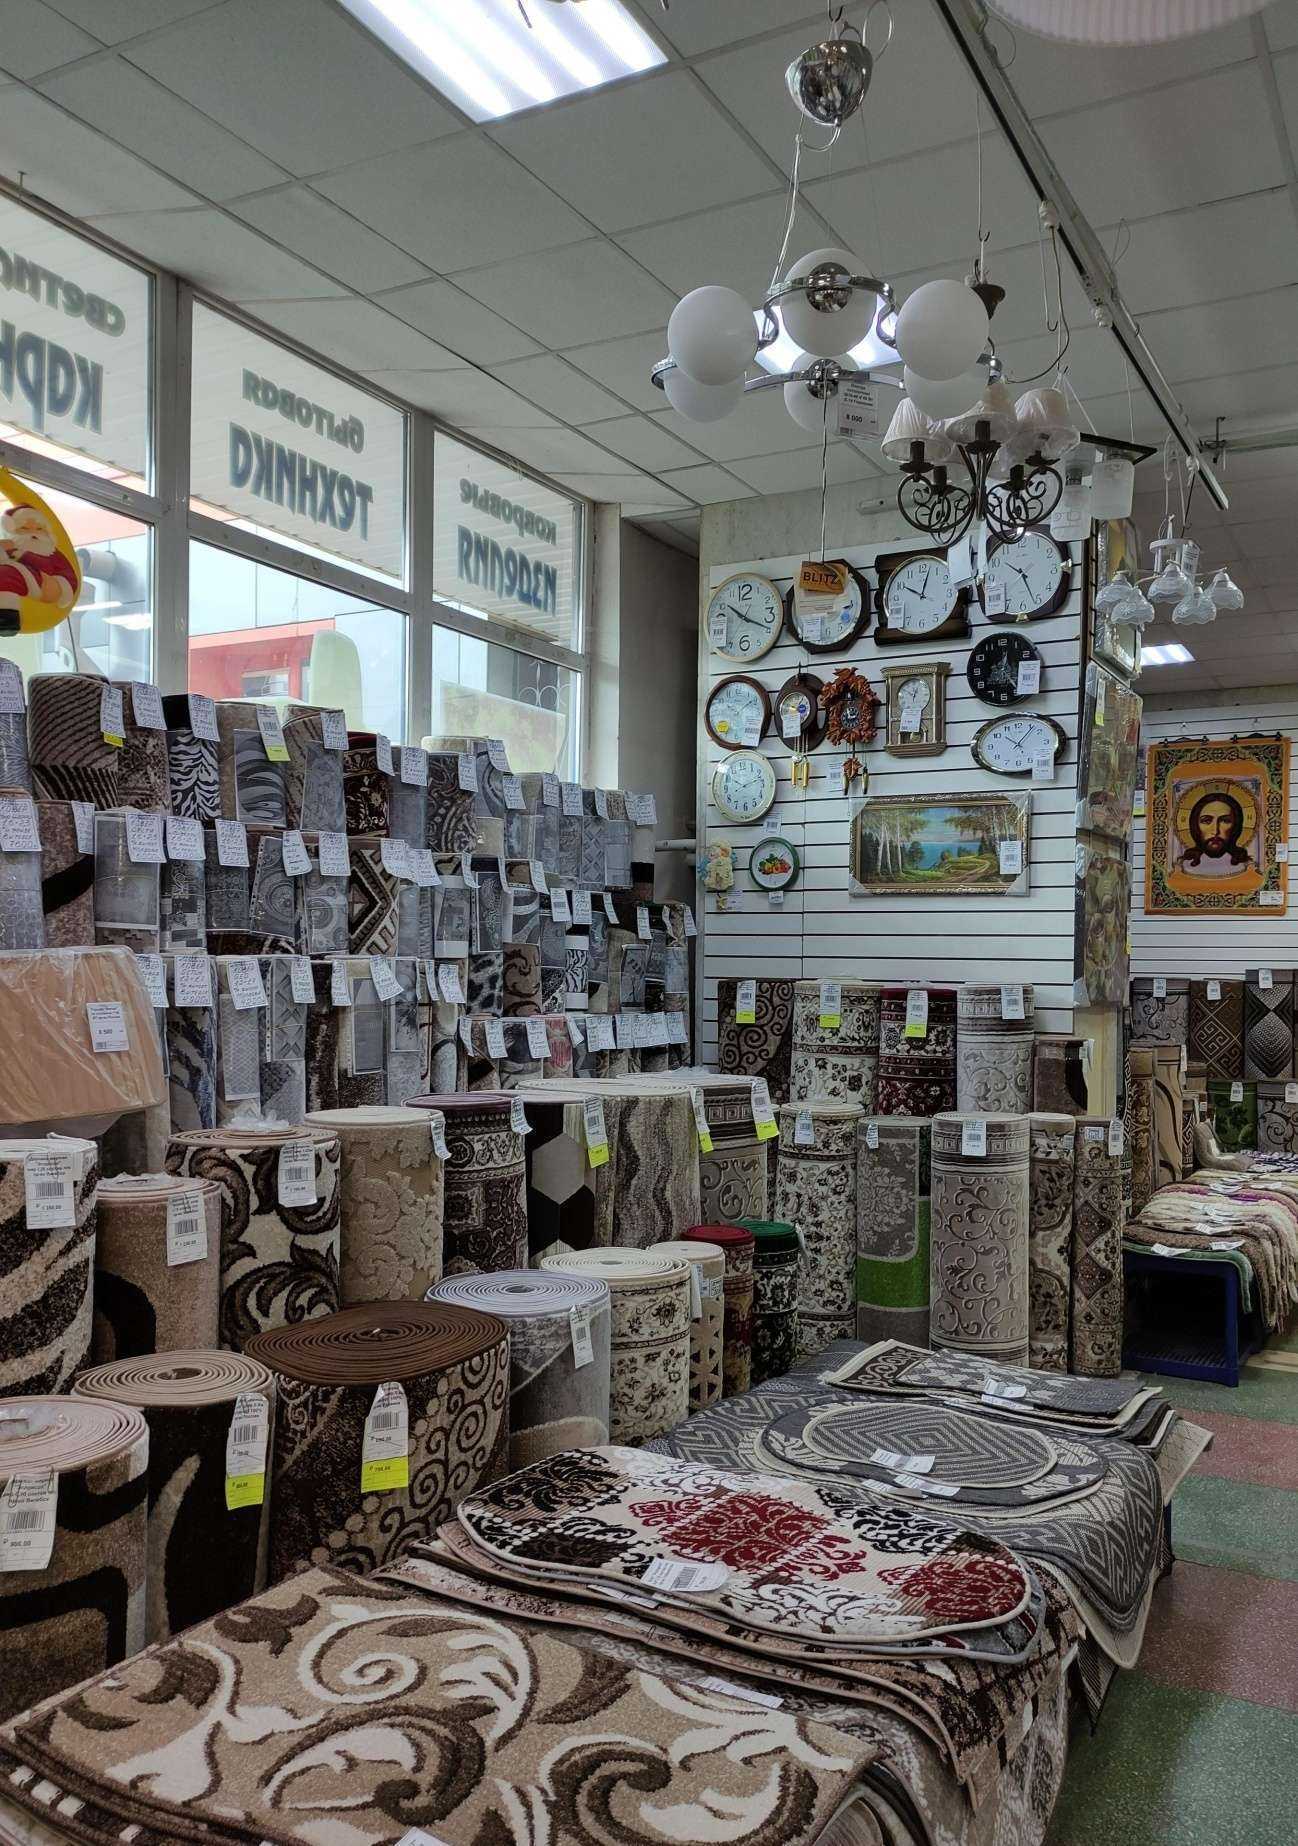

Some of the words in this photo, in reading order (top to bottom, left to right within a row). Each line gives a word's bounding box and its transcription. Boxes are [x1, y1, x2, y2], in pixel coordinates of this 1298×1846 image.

[1046, 548, 1053, 558] 2
[1051, 564, 1057, 574] 3
[803, 571, 840, 585] BLITZ
[739, 584, 752, 602] 12
[1020, 600, 1026, 611] 6
[764, 607, 775, 623] 3
[740, 635, 750, 651] 6
